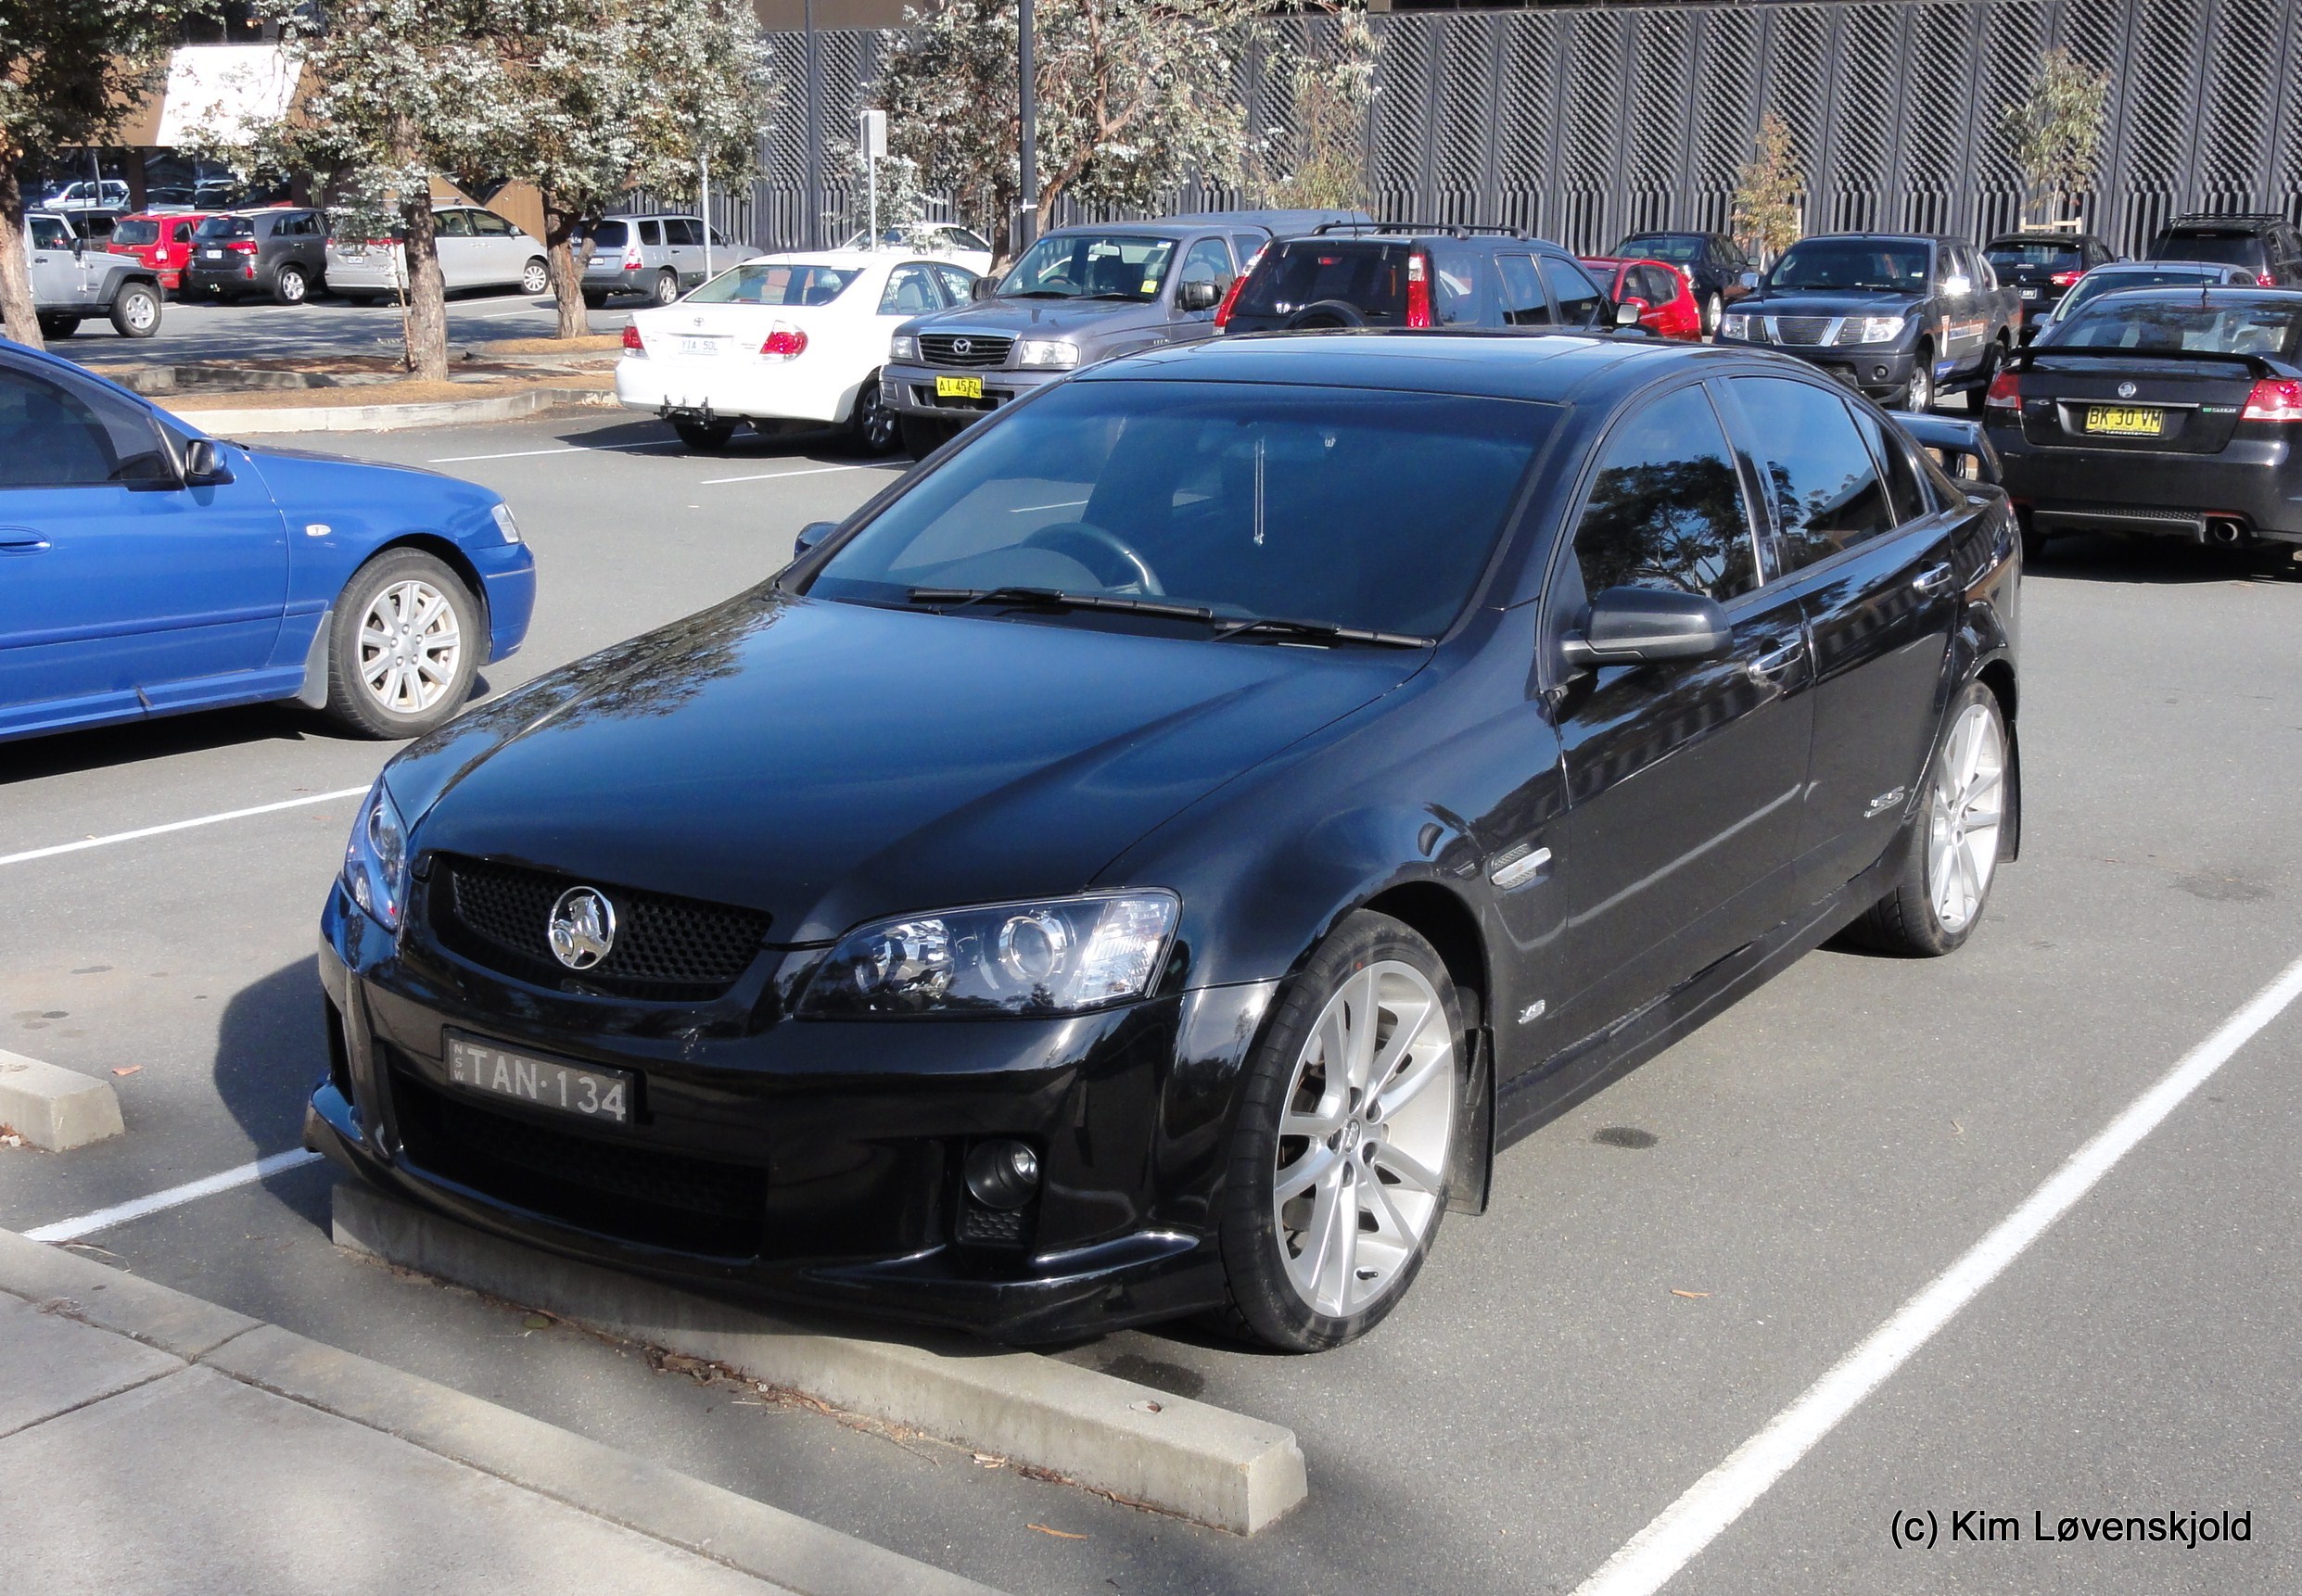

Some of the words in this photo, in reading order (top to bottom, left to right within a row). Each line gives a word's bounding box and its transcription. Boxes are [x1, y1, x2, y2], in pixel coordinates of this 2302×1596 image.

[2089, 407, 2111, 425] BK
[2115, 408, 2136, 426] 30
[2142, 408, 2162, 427] VM
